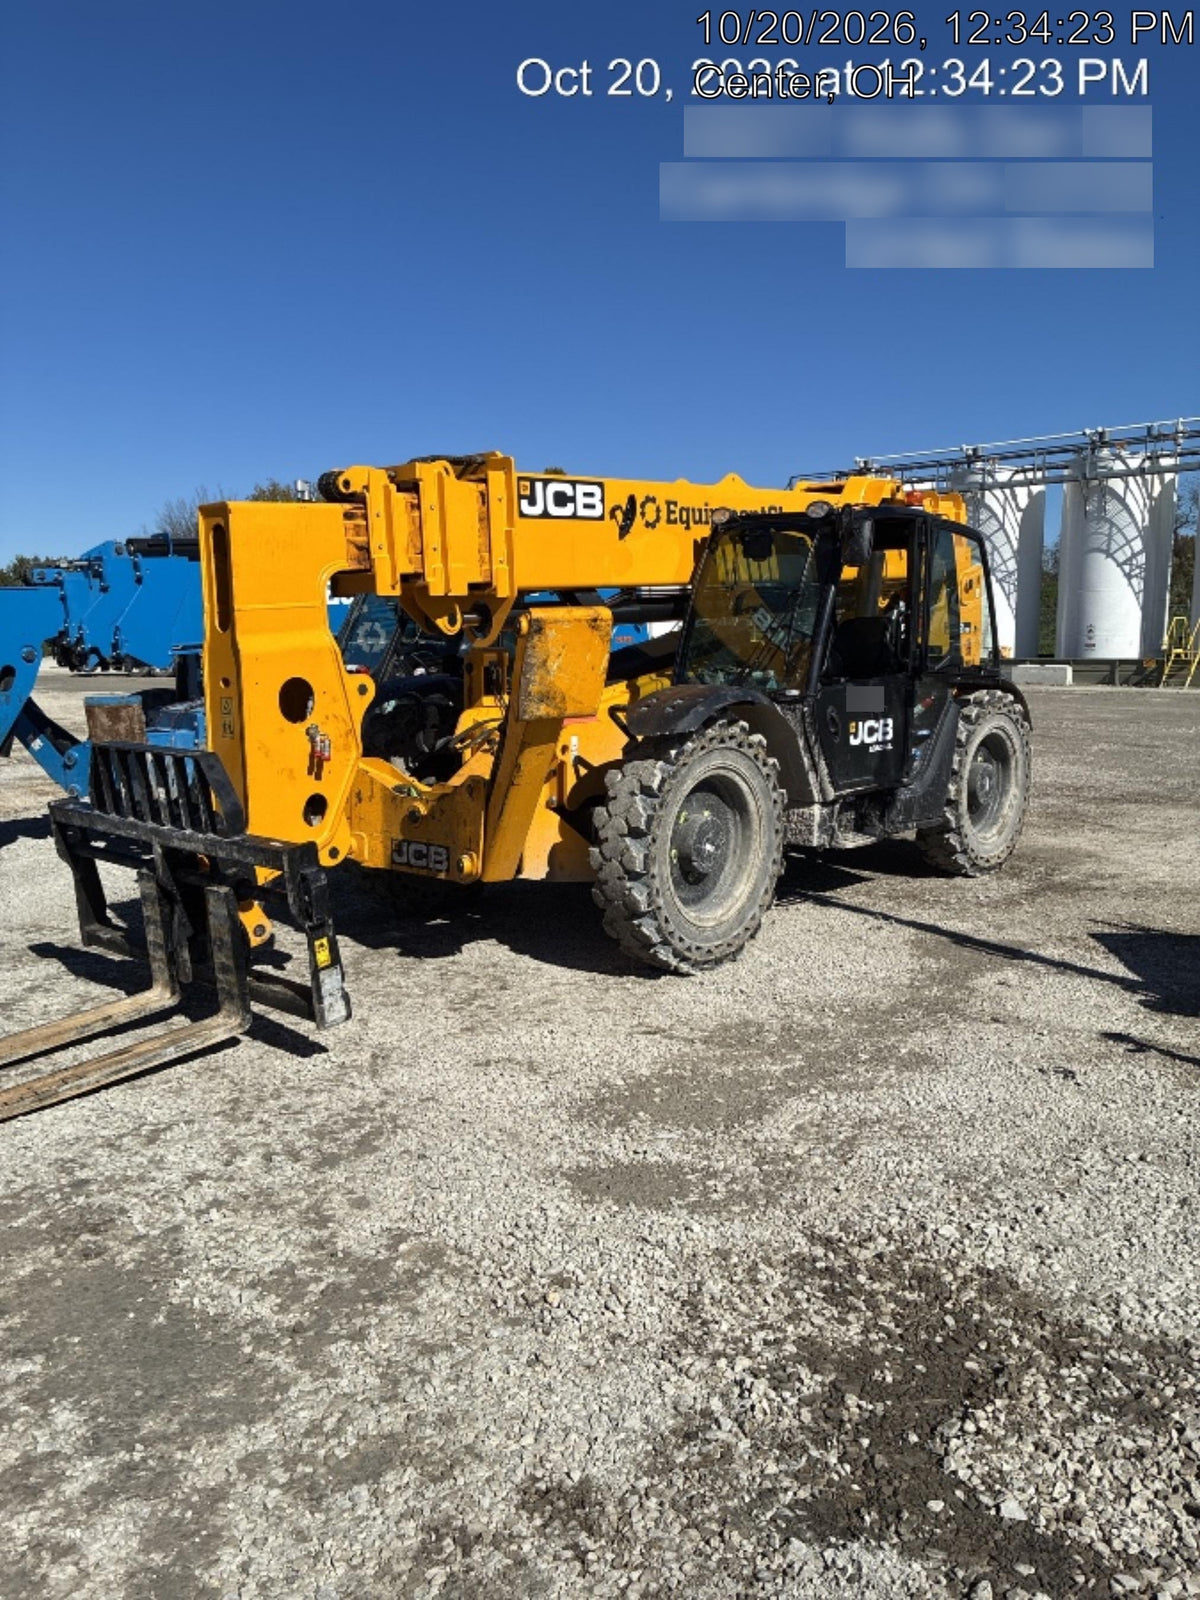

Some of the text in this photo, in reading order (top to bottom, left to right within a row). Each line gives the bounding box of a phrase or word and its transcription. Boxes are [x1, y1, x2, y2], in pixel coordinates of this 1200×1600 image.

[520, 481, 604, 518] JCB
[849, 718, 893, 746] JCB
[393, 841, 449, 871] JCB
